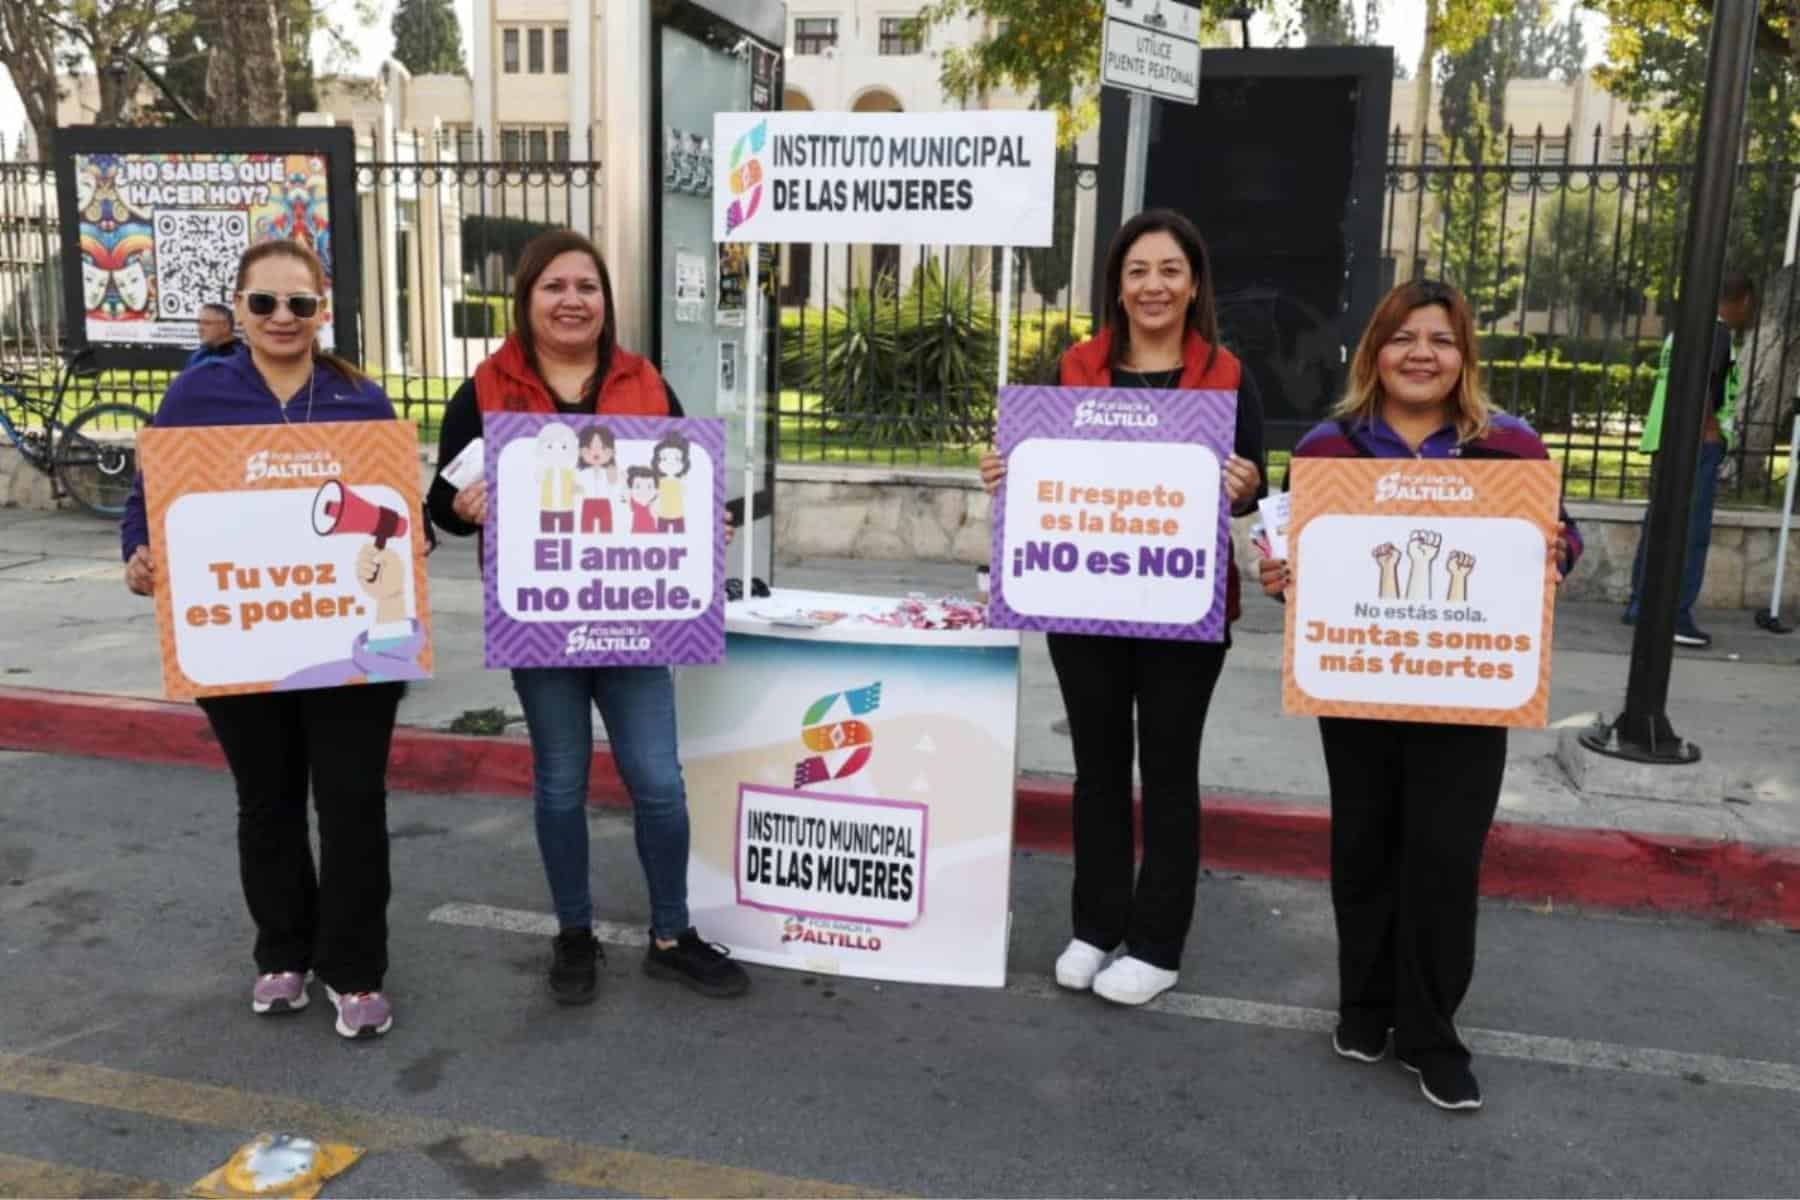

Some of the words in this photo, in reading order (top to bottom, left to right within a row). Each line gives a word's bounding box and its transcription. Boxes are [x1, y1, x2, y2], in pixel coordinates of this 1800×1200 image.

[1107, 51, 1145, 75] PUENTE
[773, 135, 884, 167] INSTITUTO
[889, 136, 1031, 167] MUNICIPAL
[115, 162, 158, 185] ¿NO
[161, 162, 235, 182] SABES
[239, 157, 284, 182] QUÉ
[130, 184, 205, 205] HACER
[210, 184, 269, 205] HOY?
[773, 179, 800, 211] DE
[805, 179, 847, 211] LAS
[853, 178, 973, 212] MUJERES
[1036, 480, 1063, 503] El
[1070, 484, 1185, 512] respeto
[1040, 514, 1072, 531] es
[1079, 511, 1104, 533] la
[1109, 511, 1179, 536] base
[534, 539, 572, 571] El
[580, 546, 687, 571] amor
[1013, 541, 1079, 578] ¡NO
[1086, 551, 1131, 576] es
[1138, 546, 1206, 579] NO!
[209, 562, 261, 590] Tu
[268, 563, 336, 588] voz
[517, 586, 569, 611] no
[577, 578, 701, 611] duele.
[186, 604, 231, 626] es
[240, 593, 365, 630] poder.
[1354, 602, 1380, 619] No
[1384, 602, 1438, 621] estás
[1443, 605, 1487, 624] sola.
[1305, 621, 1419, 647] Juntas
[1427, 629, 1531, 651] somos
[1319, 649, 1383, 674] más
[1390, 652, 1514, 680] fuertes
[748, 808, 825, 849] INSTITUTO
[830, 820, 915, 858] MUNICIPAL
[747, 845, 773, 884] DE
[776, 849, 813, 890] LAS
[818, 855, 913, 902] MUJERES
